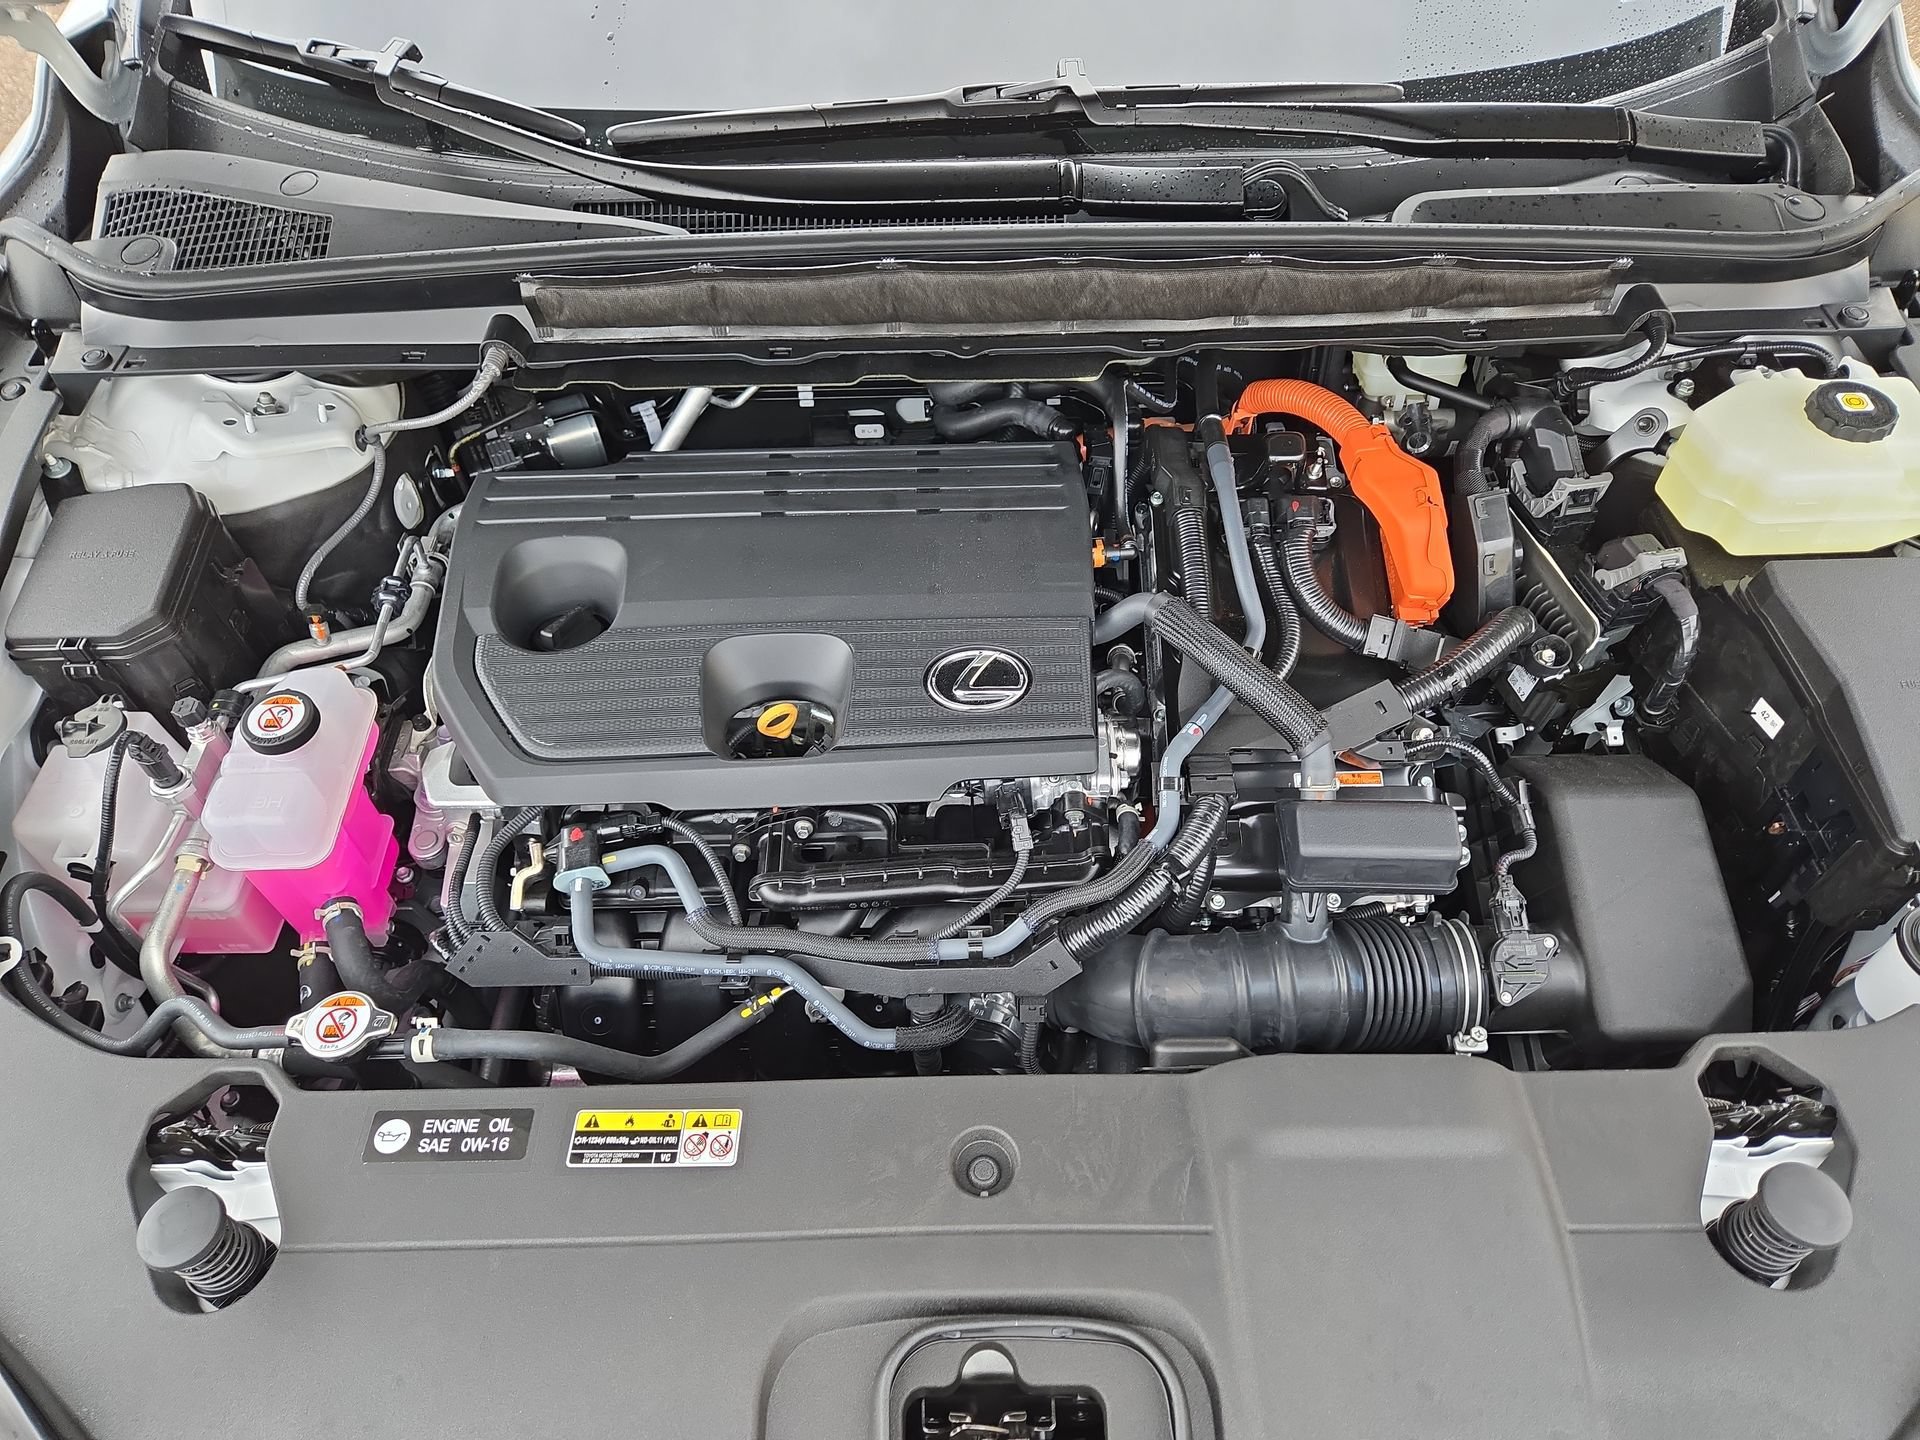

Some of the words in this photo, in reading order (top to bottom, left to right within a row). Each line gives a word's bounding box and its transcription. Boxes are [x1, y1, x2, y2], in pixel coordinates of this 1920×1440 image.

[422, 1118, 480, 1134] ENGINE
[489, 1118, 513, 1133] OIL
[418, 1138, 451, 1153] SAE
[460, 1137, 510, 1153] 0W-16
[660, 1153, 671, 1162] VC
